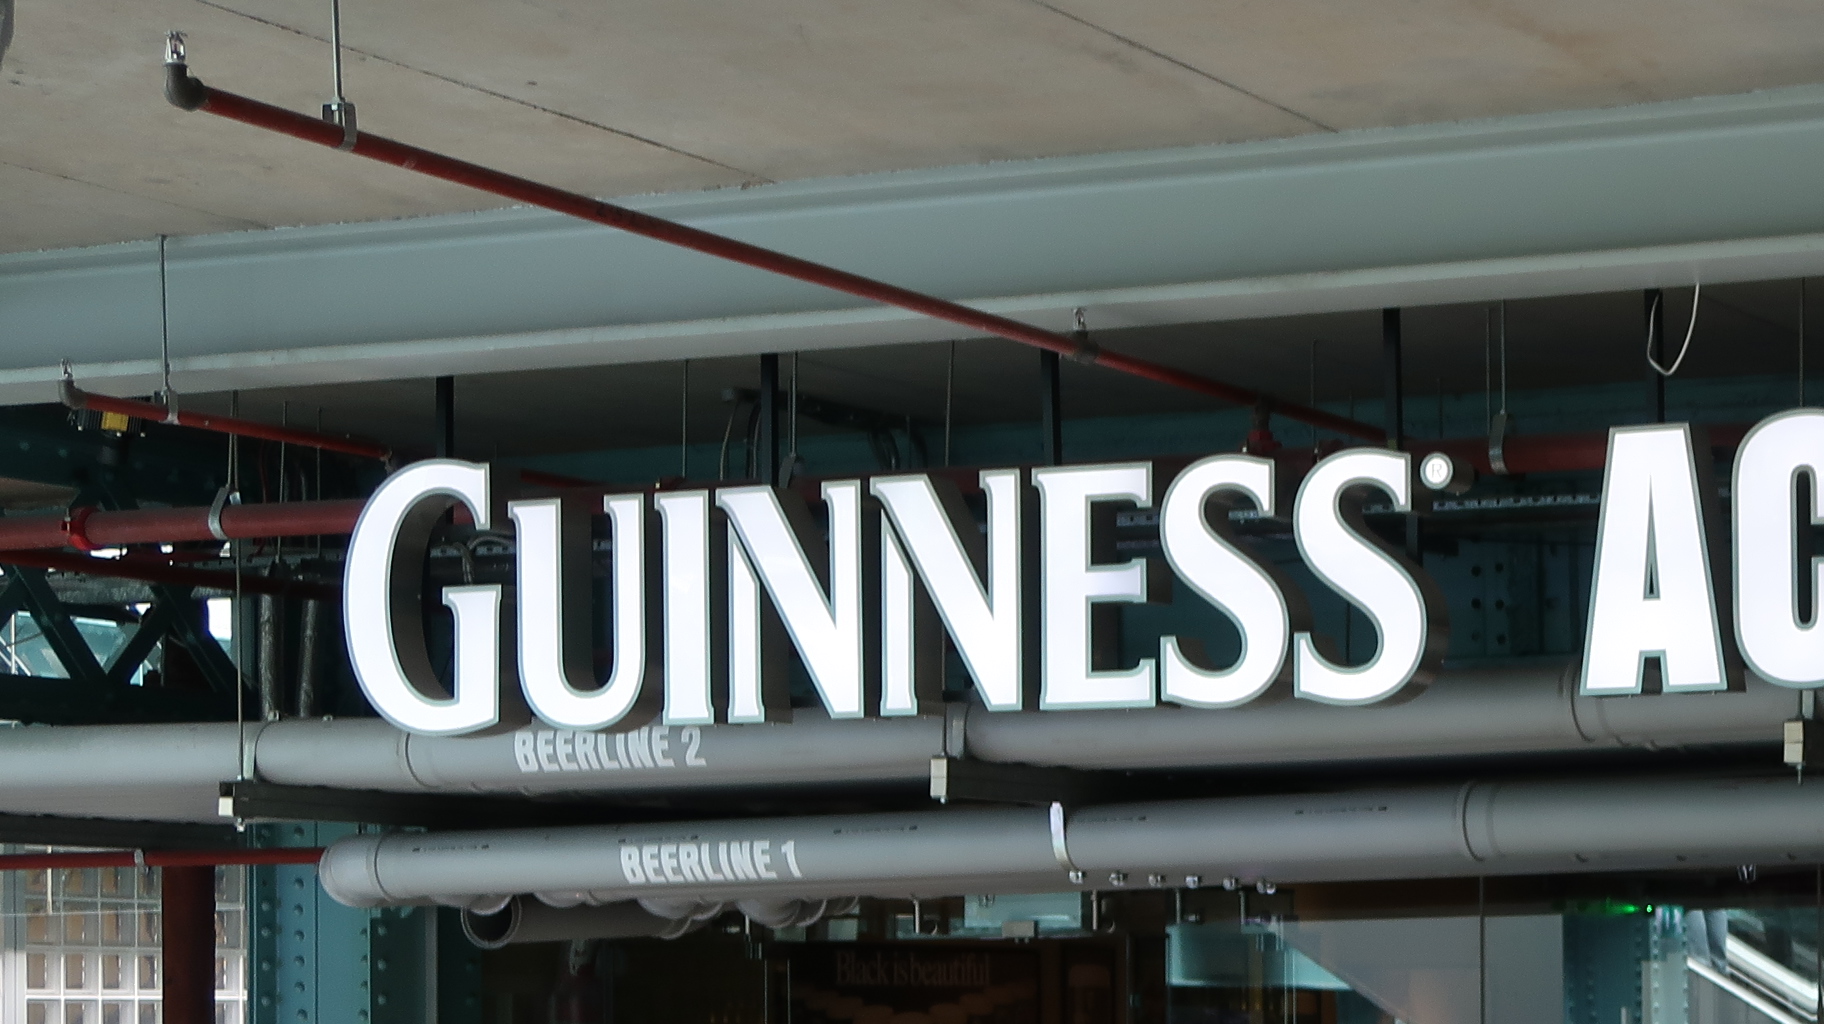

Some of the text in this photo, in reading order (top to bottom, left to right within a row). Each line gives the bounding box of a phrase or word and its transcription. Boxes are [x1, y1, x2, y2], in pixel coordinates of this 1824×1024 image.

[342, 446, 1428, 736] GUINNESS
[514, 725, 706, 773] BEERLINE 2
[619, 840, 802, 885] BEERLINE 1
